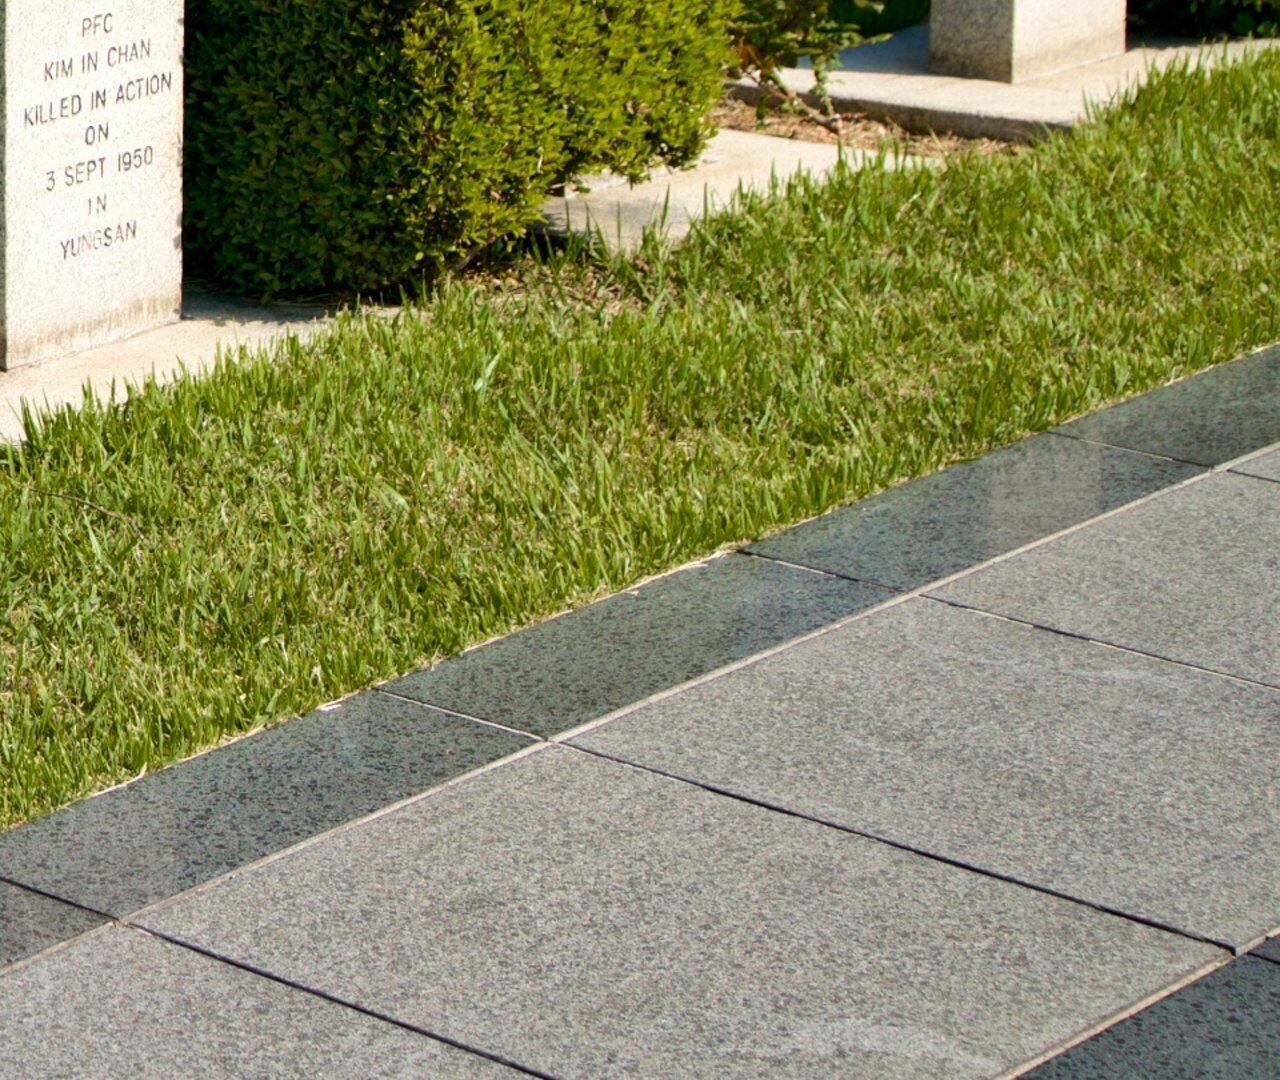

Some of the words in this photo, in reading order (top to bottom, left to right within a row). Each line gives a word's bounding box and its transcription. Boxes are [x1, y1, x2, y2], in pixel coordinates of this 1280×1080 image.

[81, 12, 114, 38] PFC
[43, 57, 74, 83] KIM
[81, 51, 99, 74] IN
[106, 38, 152, 68] CHAN
[23, 93, 83, 129] KILLED
[90, 88, 108, 111] IN
[115, 71, 173, 105] ACTION
[84, 121, 110, 147] ON
[45, 170, 56, 192] 3
[64, 156, 107, 188] SEPT
[117, 145, 154, 173] 1950
[87, 193, 108, 216] IN
[59, 220, 138, 261] YUNGSAN
